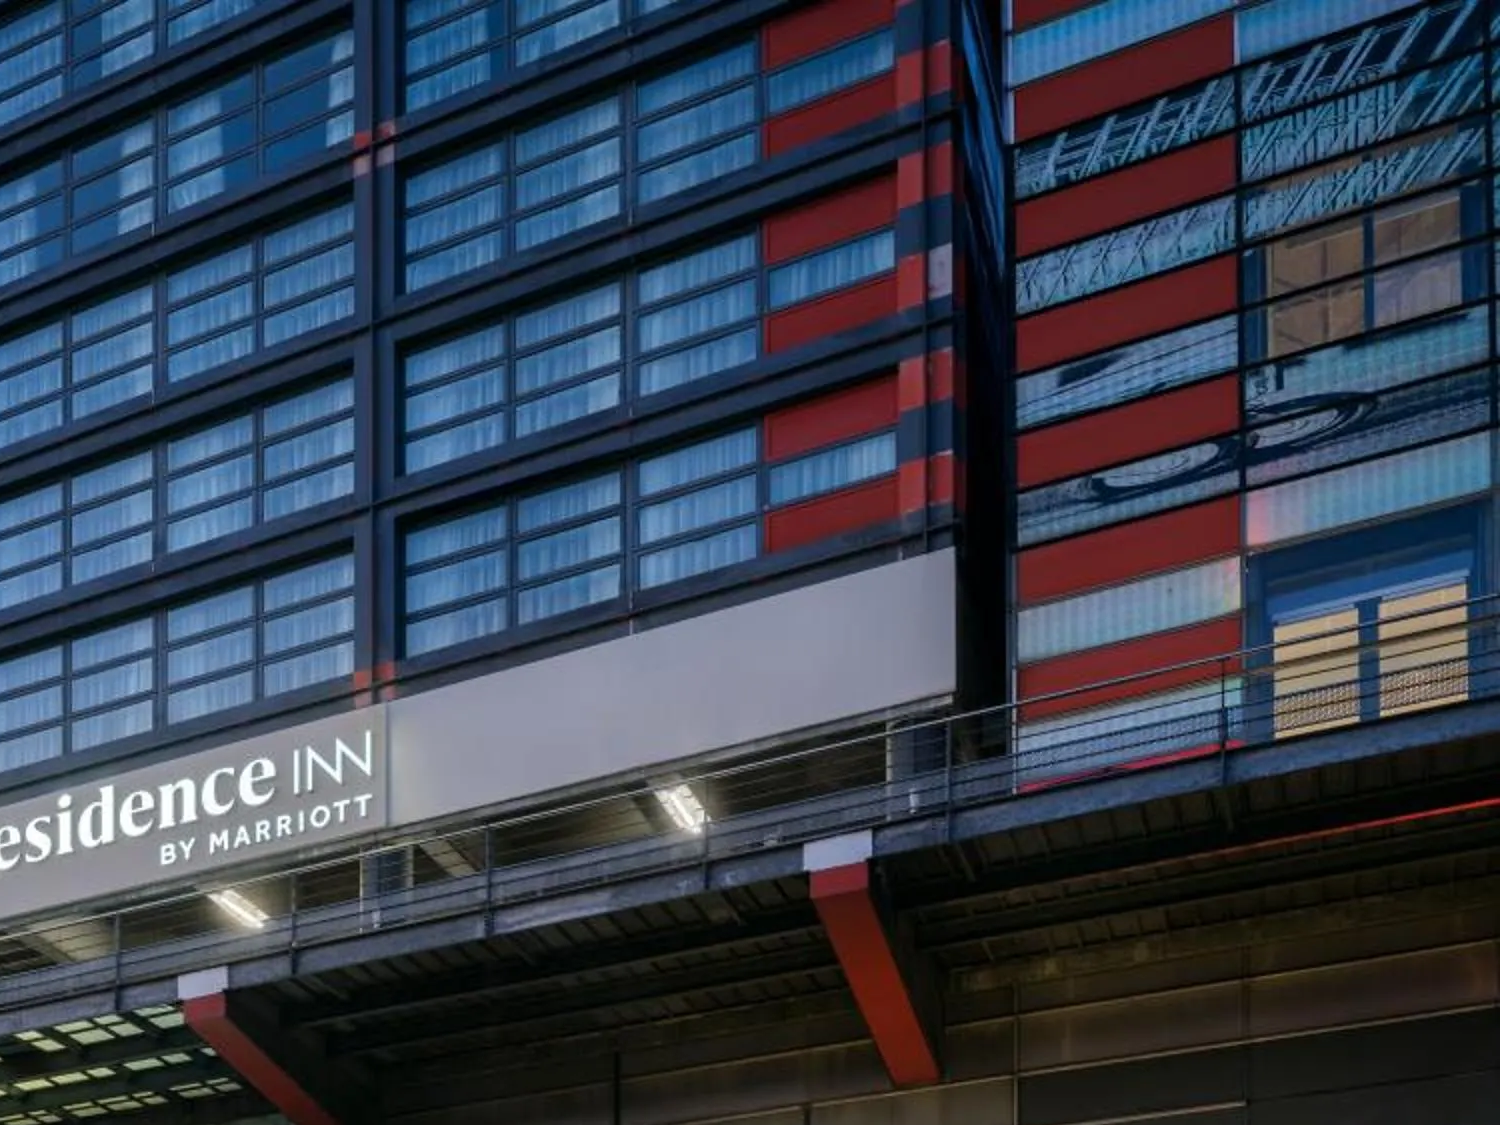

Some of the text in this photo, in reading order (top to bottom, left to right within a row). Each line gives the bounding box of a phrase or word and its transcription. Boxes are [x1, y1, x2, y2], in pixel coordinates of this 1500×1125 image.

[293, 730, 372, 795] INN
[160, 793, 372, 866] BY MARRIOTT
